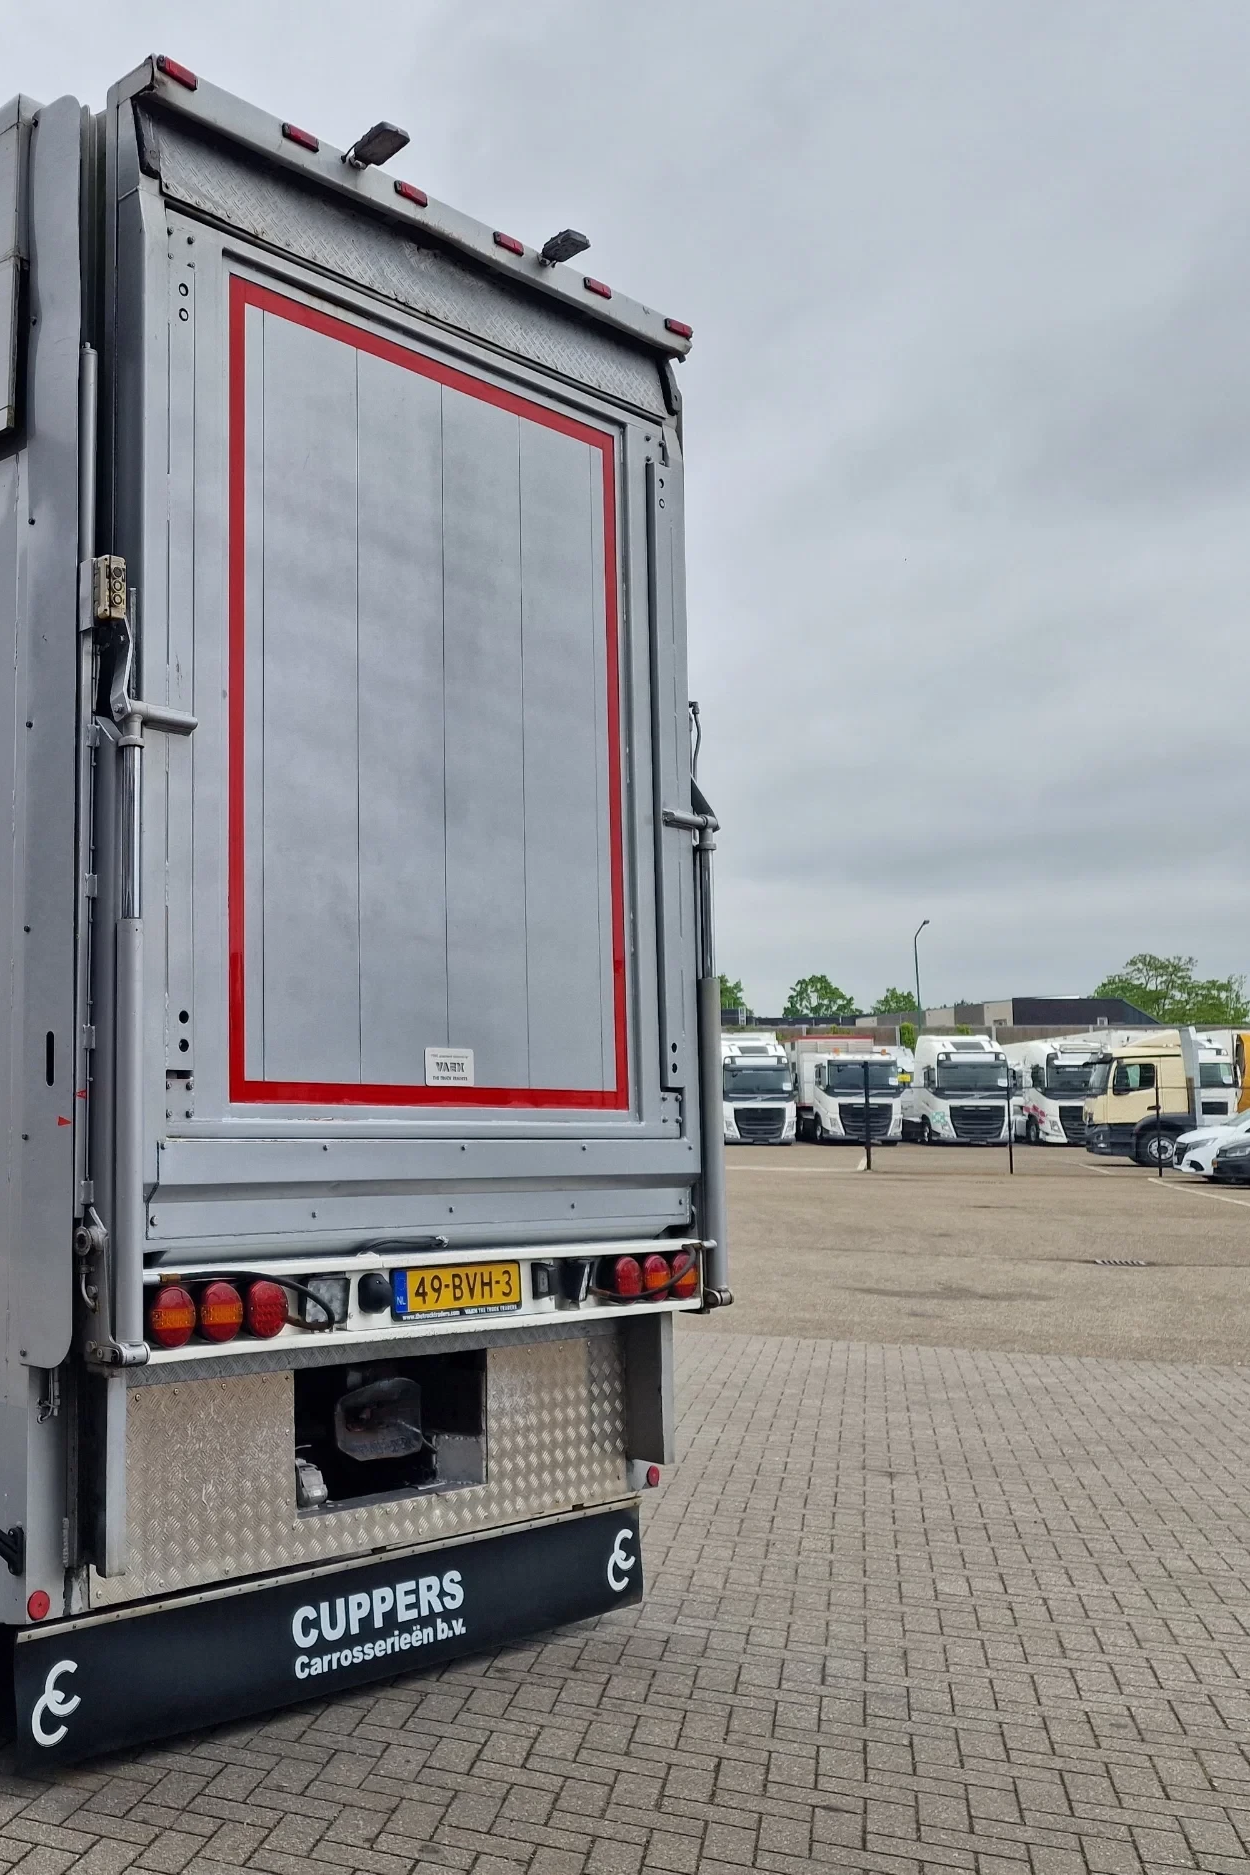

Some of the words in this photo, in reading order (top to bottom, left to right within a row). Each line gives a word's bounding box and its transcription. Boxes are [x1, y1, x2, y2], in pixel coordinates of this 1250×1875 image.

[396, 1296, 406, 1305] NL
[414, 1270, 513, 1304] 49-BVH-3
[292, 1570, 465, 1648] CUPPERS
[294, 1625, 434, 1680] Carrosserieën
[436, 1617, 466, 1641] b.v.
